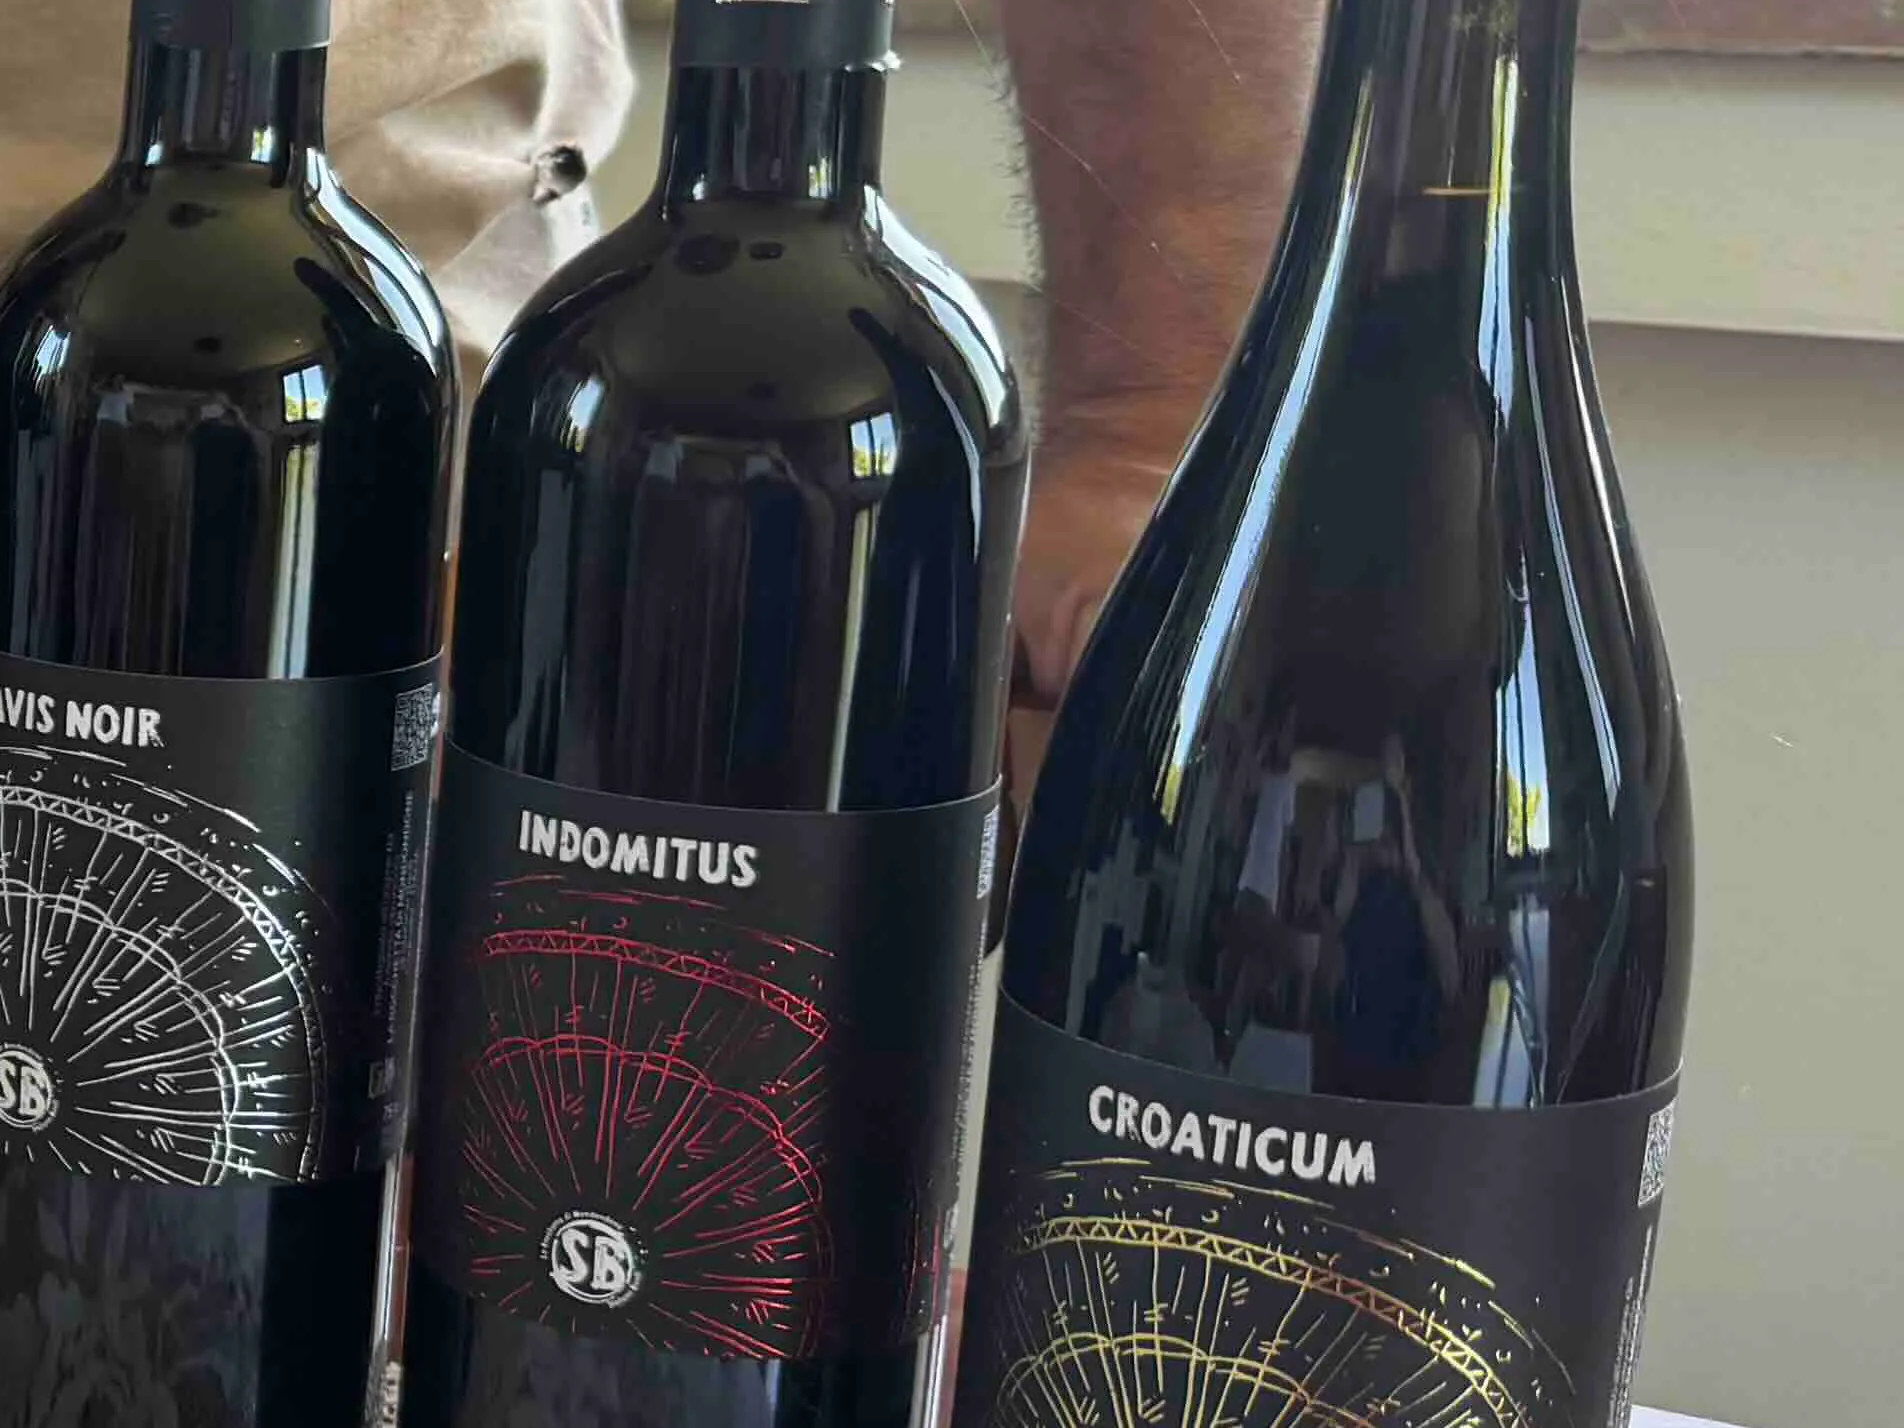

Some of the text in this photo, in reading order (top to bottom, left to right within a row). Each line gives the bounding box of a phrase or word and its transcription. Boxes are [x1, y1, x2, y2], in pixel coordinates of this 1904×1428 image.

[65, 700, 164, 748] NOIR
[517, 809, 760, 889] INDOMITUS
[1087, 1085, 1377, 1187] CROATICUM
[560, 1227, 626, 1292] SB
